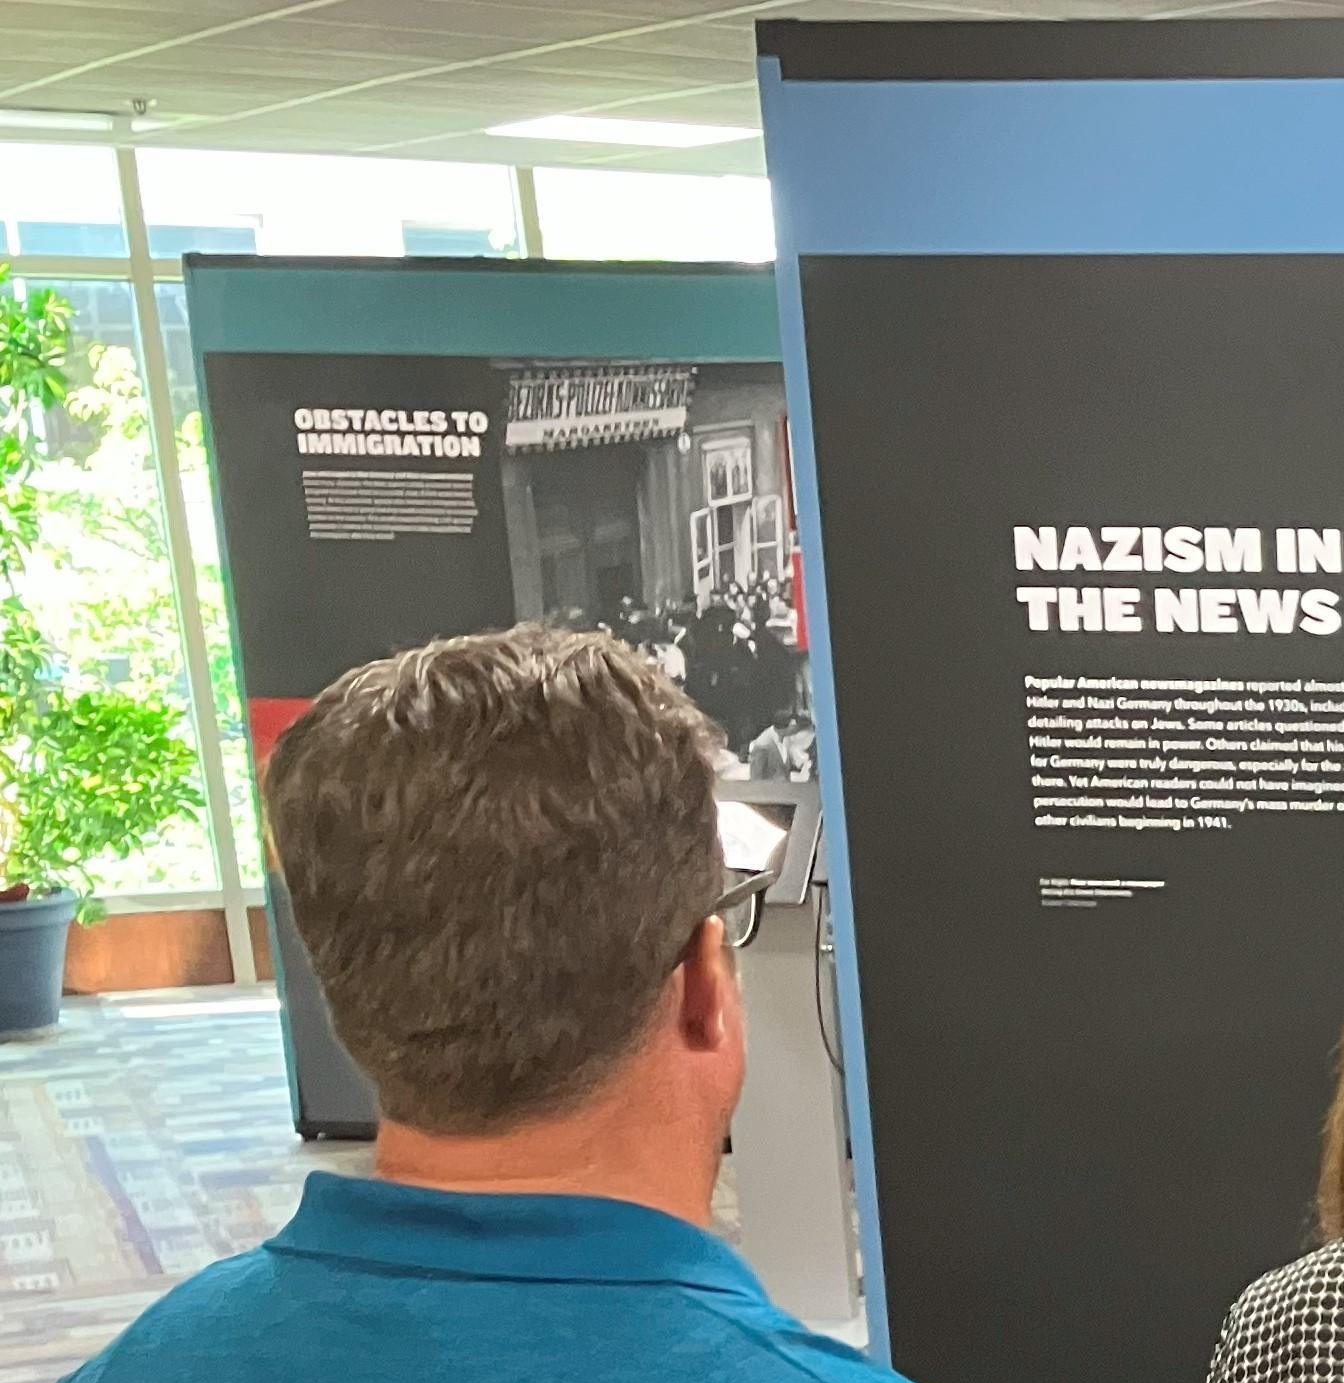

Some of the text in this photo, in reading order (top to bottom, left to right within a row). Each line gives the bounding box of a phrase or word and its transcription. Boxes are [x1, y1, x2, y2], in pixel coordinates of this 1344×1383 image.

[295, 407, 488, 434] OBSTACLES TO
[297, 433, 481, 458] IMMIGRATION
[1013, 525, 1342, 574] NAZISM IN
[1016, 586, 1342, 636] THE NEWS
[1025, 675, 1076, 692] Popular
[1077, 676, 1139, 690] American
[1141, 678, 1244, 694] newsmagazines
[1246, 679, 1302, 695] reported
[1026, 695, 1060, 709] Hitler
[1062, 696, 1086, 709] and
[1087, 696, 1115, 709] Nazi
[1117, 697, 1172, 714] Germany
[1174, 697, 1243, 714] throughout
[1245, 698, 1265, 711] the
[1027, 715, 1083, 732] detailing
[1085, 716, 1129, 729] attacks
[1131, 719, 1148, 729] on
[1188, 717, 1224, 731] Some
[1226, 718, 1273, 731] articles
